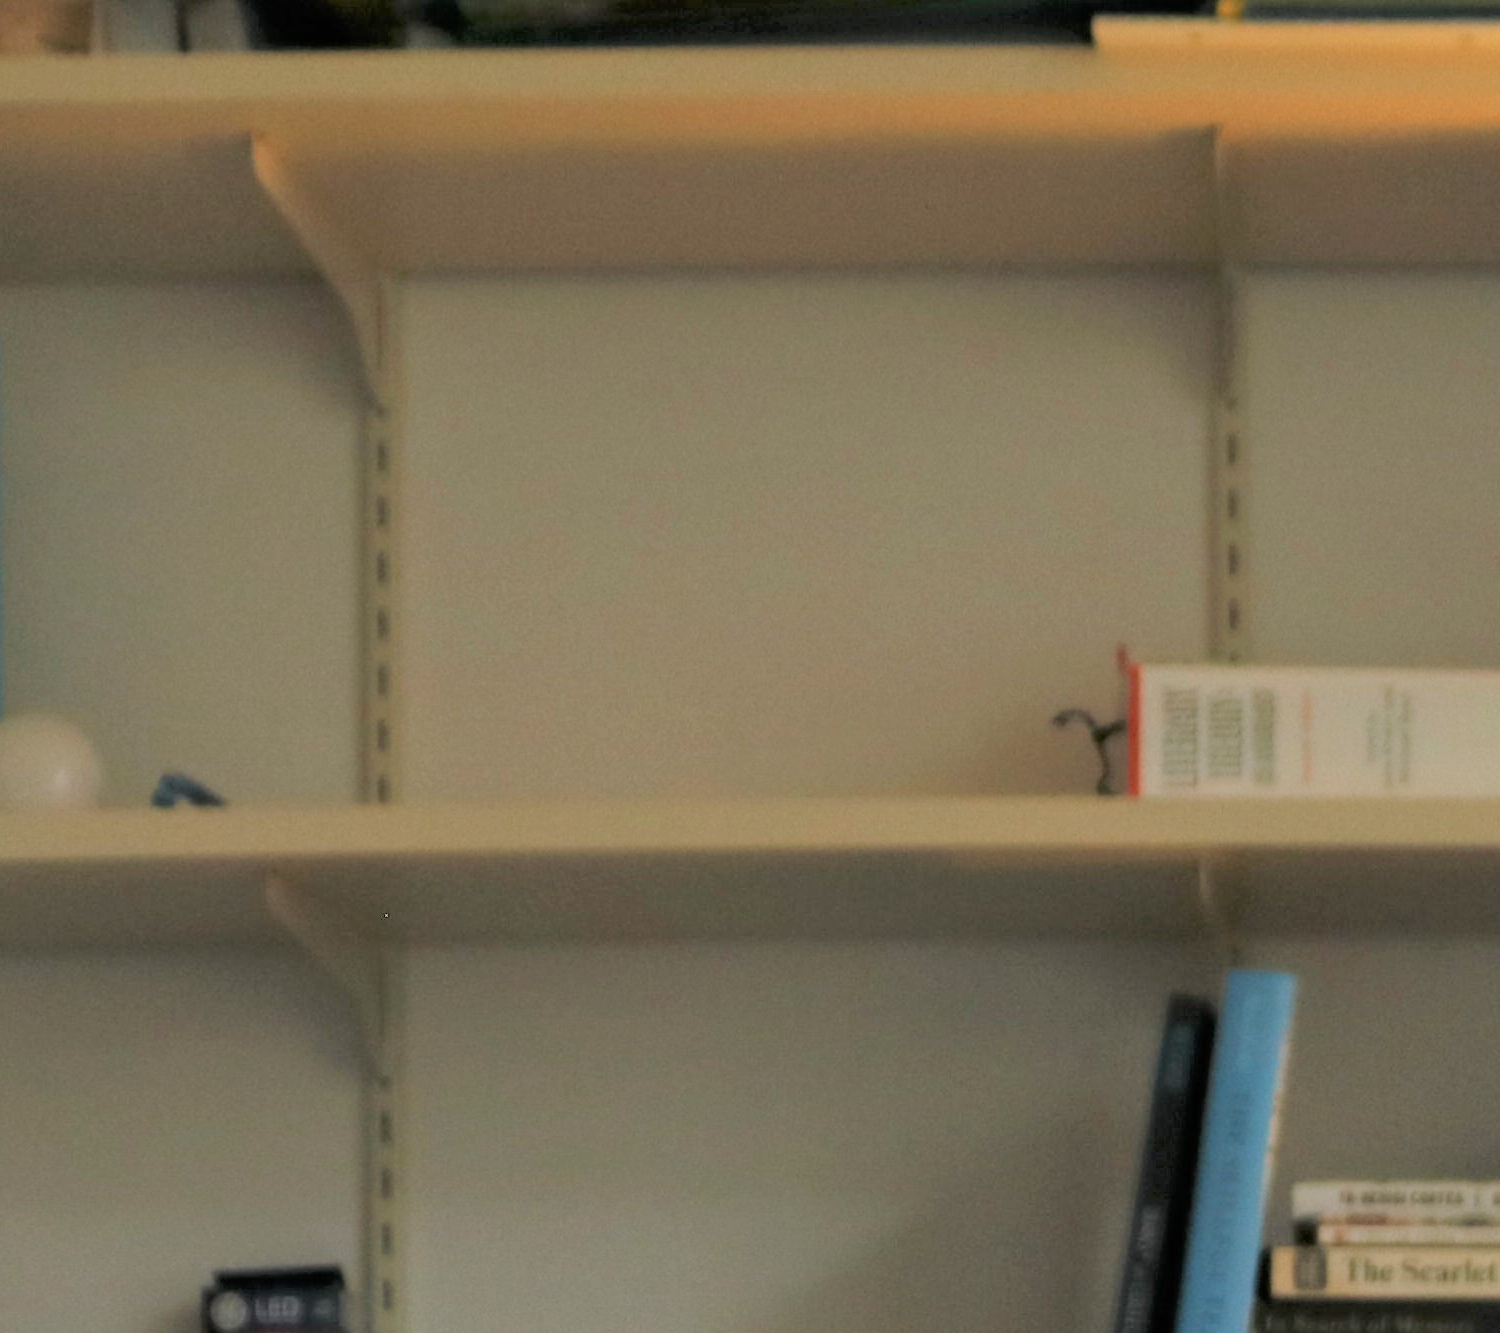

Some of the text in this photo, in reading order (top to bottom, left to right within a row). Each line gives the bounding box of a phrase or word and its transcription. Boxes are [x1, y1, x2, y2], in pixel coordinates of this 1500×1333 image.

[1229, 1094, 1252, 1146] THE
[1346, 1256, 1404, 1284] The
[1408, 1256, 1498, 1284] Scarlet
[254, 1296, 300, 1320] LED
